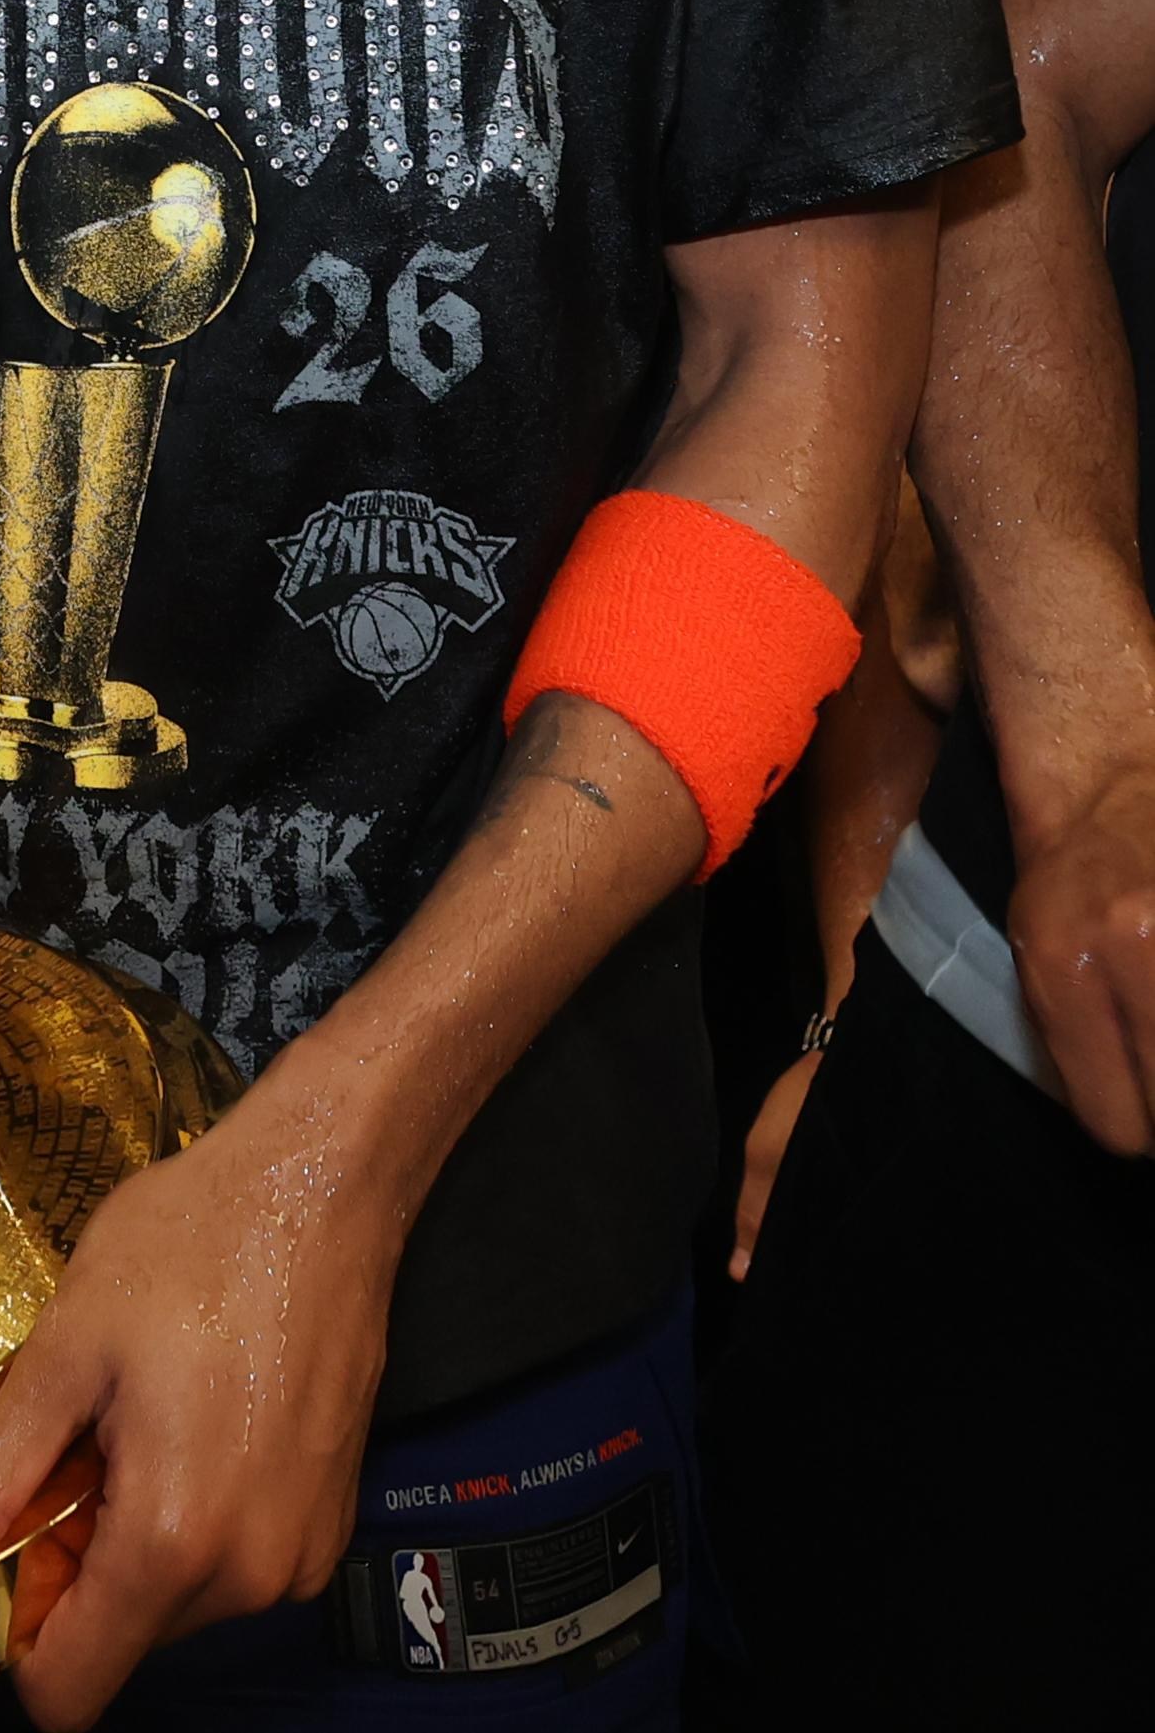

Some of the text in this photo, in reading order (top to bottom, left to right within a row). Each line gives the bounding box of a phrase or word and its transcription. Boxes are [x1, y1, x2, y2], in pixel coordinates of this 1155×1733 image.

[273, 241, 489, 413] 26
[345, 494, 431, 520] NEW YORK
[284, 511, 494, 605] KNICKS
[385, 1485, 436, 1511] ONCE
[440, 1483, 452, 1505] A
[455, 1474, 518, 1503] KNICK,
[520, 1452, 585, 1490] ALWAYS
[586, 1448, 597, 1468] A
[473, 1579, 500, 1602] 54
[409, 1645, 434, 1665] NBA
[471, 1636, 539, 1664] FINALS
